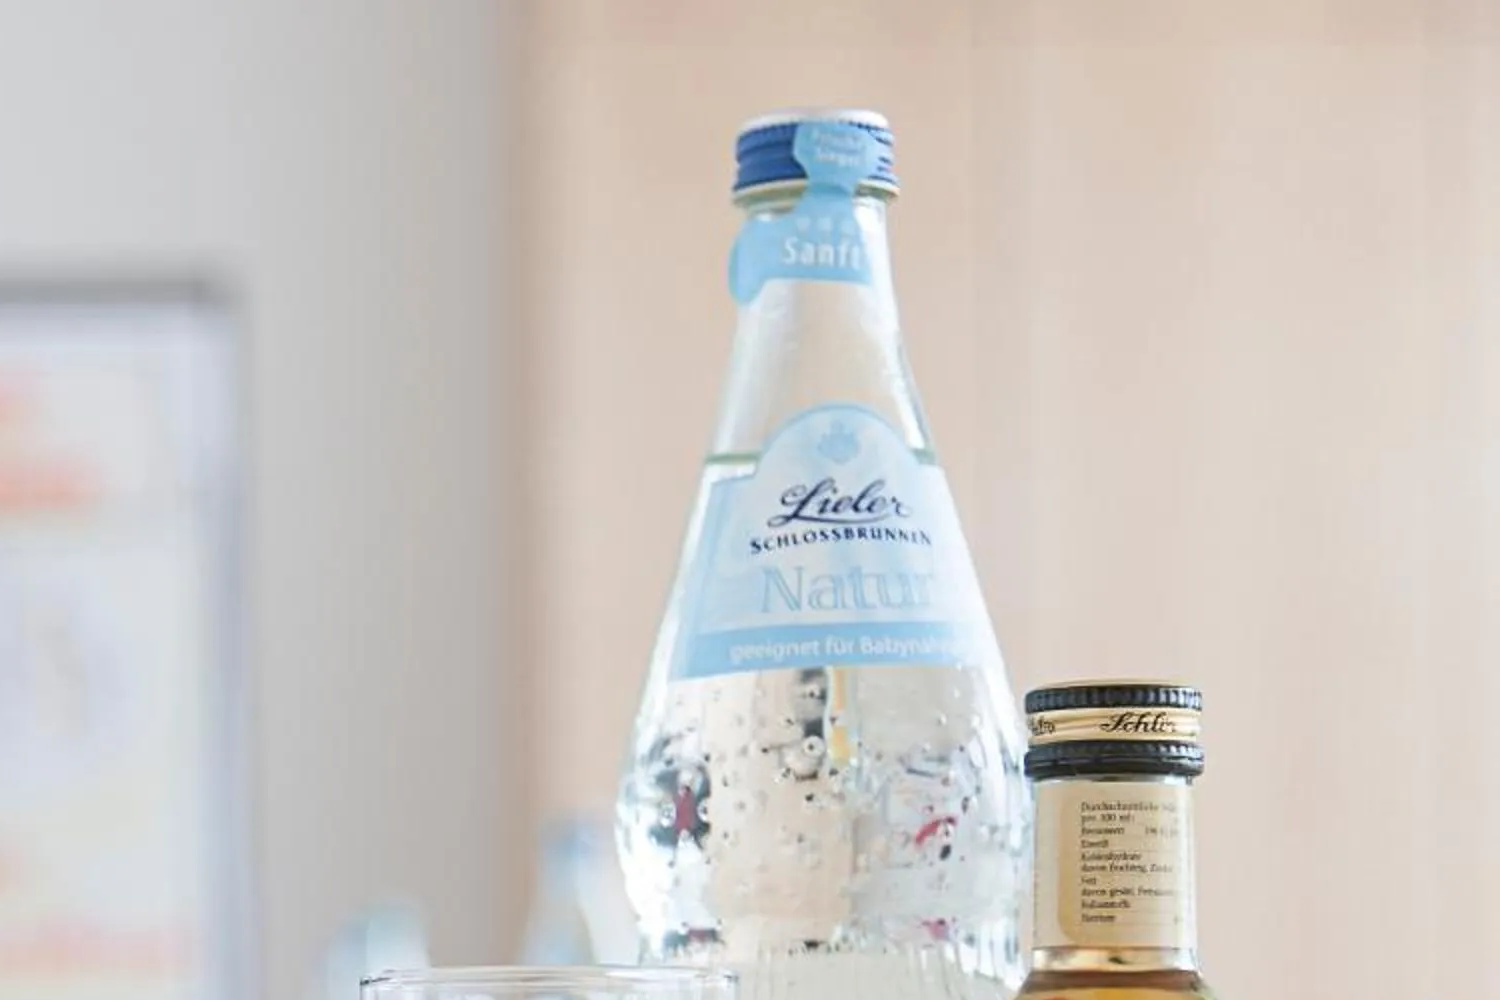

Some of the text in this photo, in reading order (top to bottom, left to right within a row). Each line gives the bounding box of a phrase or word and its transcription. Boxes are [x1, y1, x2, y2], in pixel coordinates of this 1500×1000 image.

[781, 235, 863, 271] Sanft
[767, 477, 912, 528] Lieler
[760, 566, 934, 613] Natur
